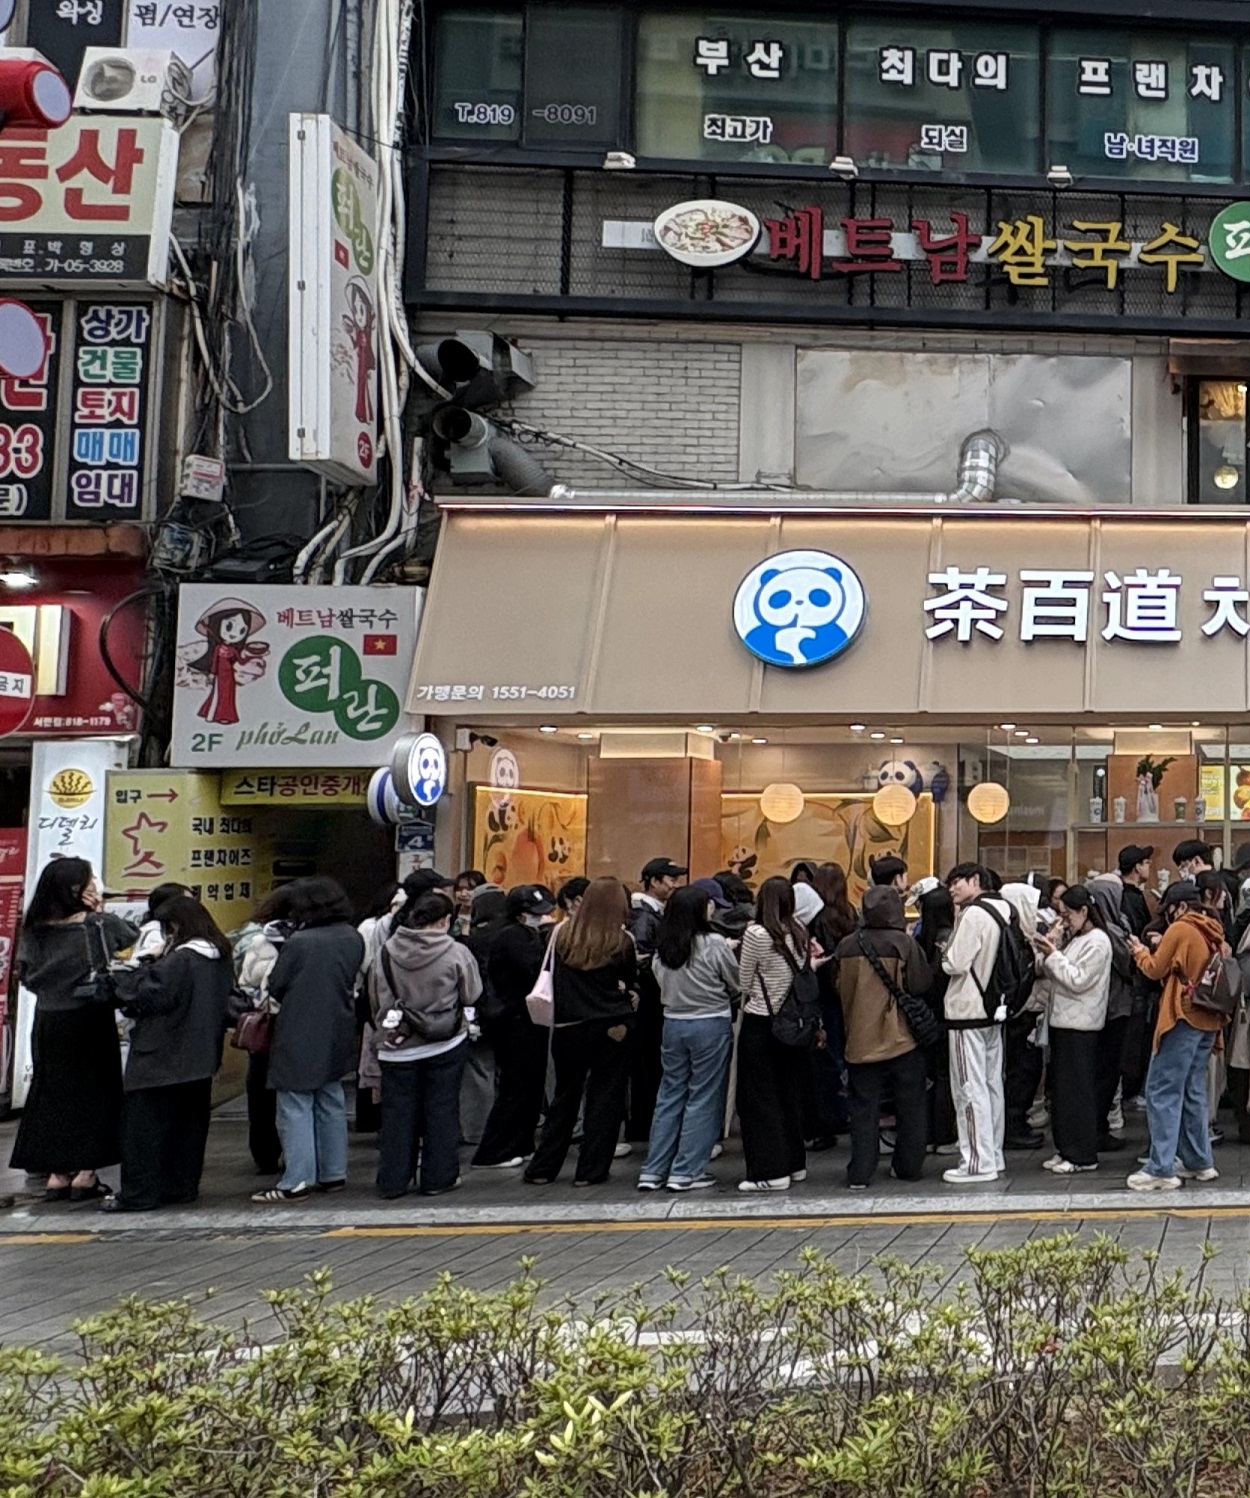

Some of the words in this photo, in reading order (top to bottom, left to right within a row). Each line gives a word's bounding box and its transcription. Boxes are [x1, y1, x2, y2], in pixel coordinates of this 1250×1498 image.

[134, 2, 220, 31] 펌/연장
[695, 37, 785, 80] 부산
[140, 75, 158, 84] LG
[455, 102, 515, 125] T.819
[704, 115, 773, 144] 최고가
[921, 125, 968, 152] 되실
[81, 305, 150, 344] 상가
[78, 346, 142, 384] 건물
[74, 387, 139, 425] 토지
[73, 428, 140, 466] 매매
[71, 469, 138, 508] 임대
[276, 607, 399, 629] 베트남쌀국수
[923, 566, 1183, 643] 茶百道
[292, 645, 389, 731] 퍼란
[416, 685, 484, 700] 가맹문의
[491, 686, 576, 699] 1551-4051
[191, 733, 224, 752] 2F
[115, 788, 142, 803] 입구
[233, 774, 368, 796] 스타공인중개
[191, 816, 214, 835] 국내
